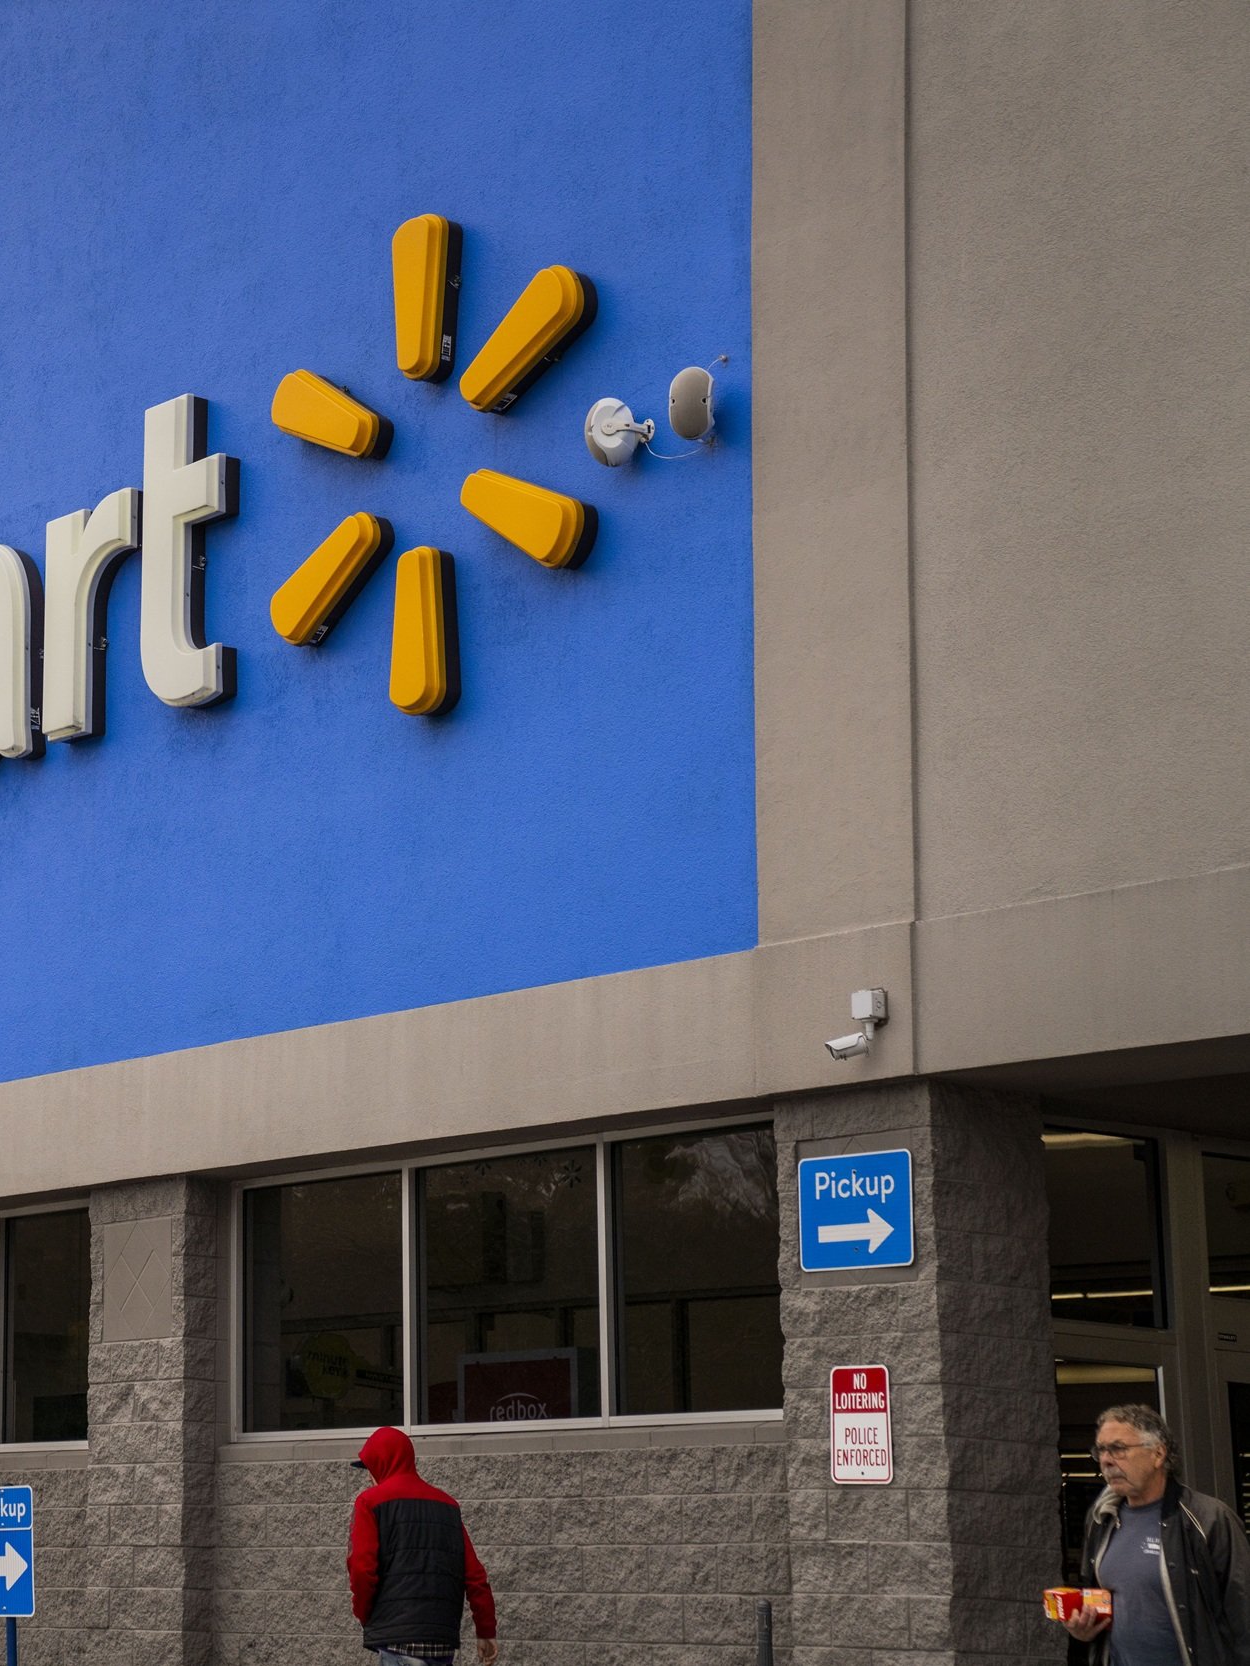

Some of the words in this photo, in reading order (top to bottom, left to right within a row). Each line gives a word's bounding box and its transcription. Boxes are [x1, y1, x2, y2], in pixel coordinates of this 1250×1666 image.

[814, 1168, 895, 1204] Pickup
[853, 1372, 867, 1390] NO
[489, 1399, 549, 1421] redbox
[835, 1392, 885, 1410] LOITERING
[844, 1427, 879, 1445] POLICE
[836, 1448, 887, 1467] ENFORCED
